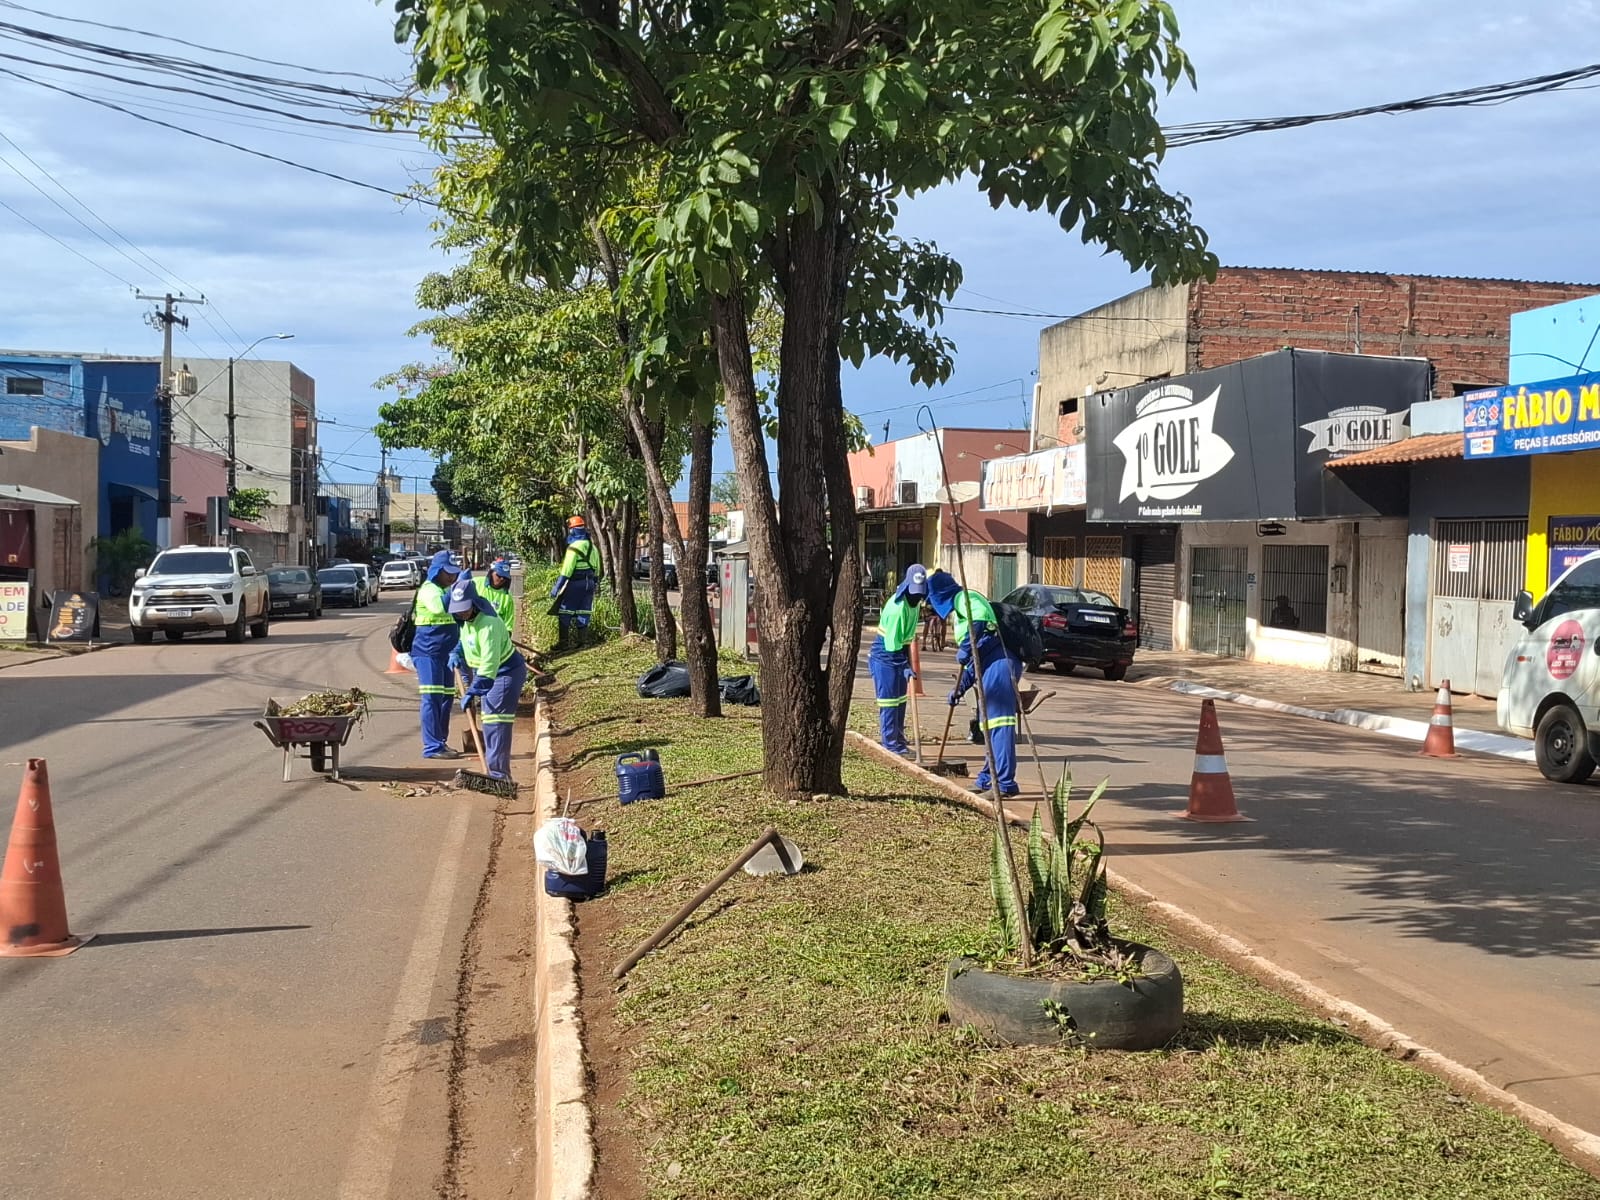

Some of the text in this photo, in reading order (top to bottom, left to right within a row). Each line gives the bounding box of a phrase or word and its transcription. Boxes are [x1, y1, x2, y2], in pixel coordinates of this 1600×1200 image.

[1503, 386, 1572, 430] FÁBIO
[1346, 419, 1391, 441] GOLE
[1153, 417, 1200, 476] GOLE
[1514, 438, 1541, 450] PEÇAS
[1543, 438, 1550, 447] E
[1553, 524, 1584, 541] FÁBIO
[7, 602, 25, 611] DE
